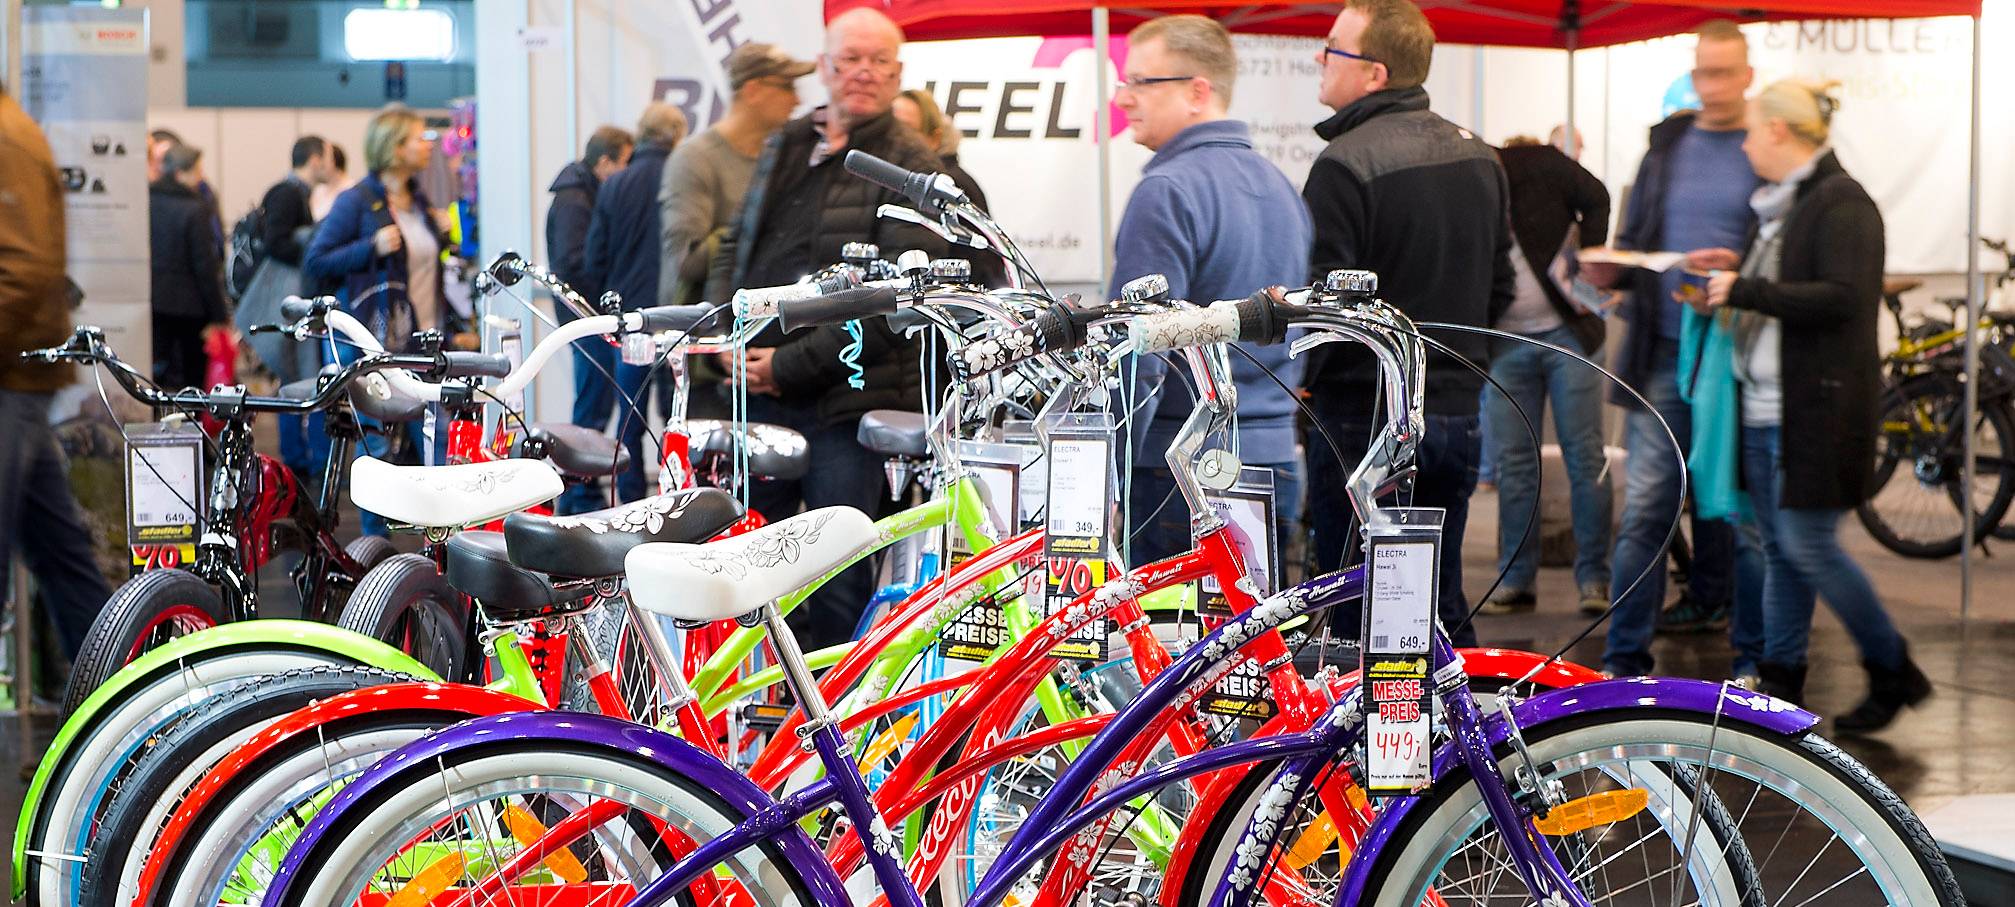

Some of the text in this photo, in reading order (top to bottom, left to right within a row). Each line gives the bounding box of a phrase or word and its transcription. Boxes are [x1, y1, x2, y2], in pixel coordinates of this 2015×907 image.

[165, 512, 193, 524] 649,-
[1076, 521, 1099, 534] 349,-
[1052, 538, 1092, 549] stadler
[1376, 550, 1408, 558] ELECTRA
[1371, 661, 1418, 672] stadler
[1373, 680, 1424, 700] MESSE-
[1379, 701, 1420, 722] PREIS
